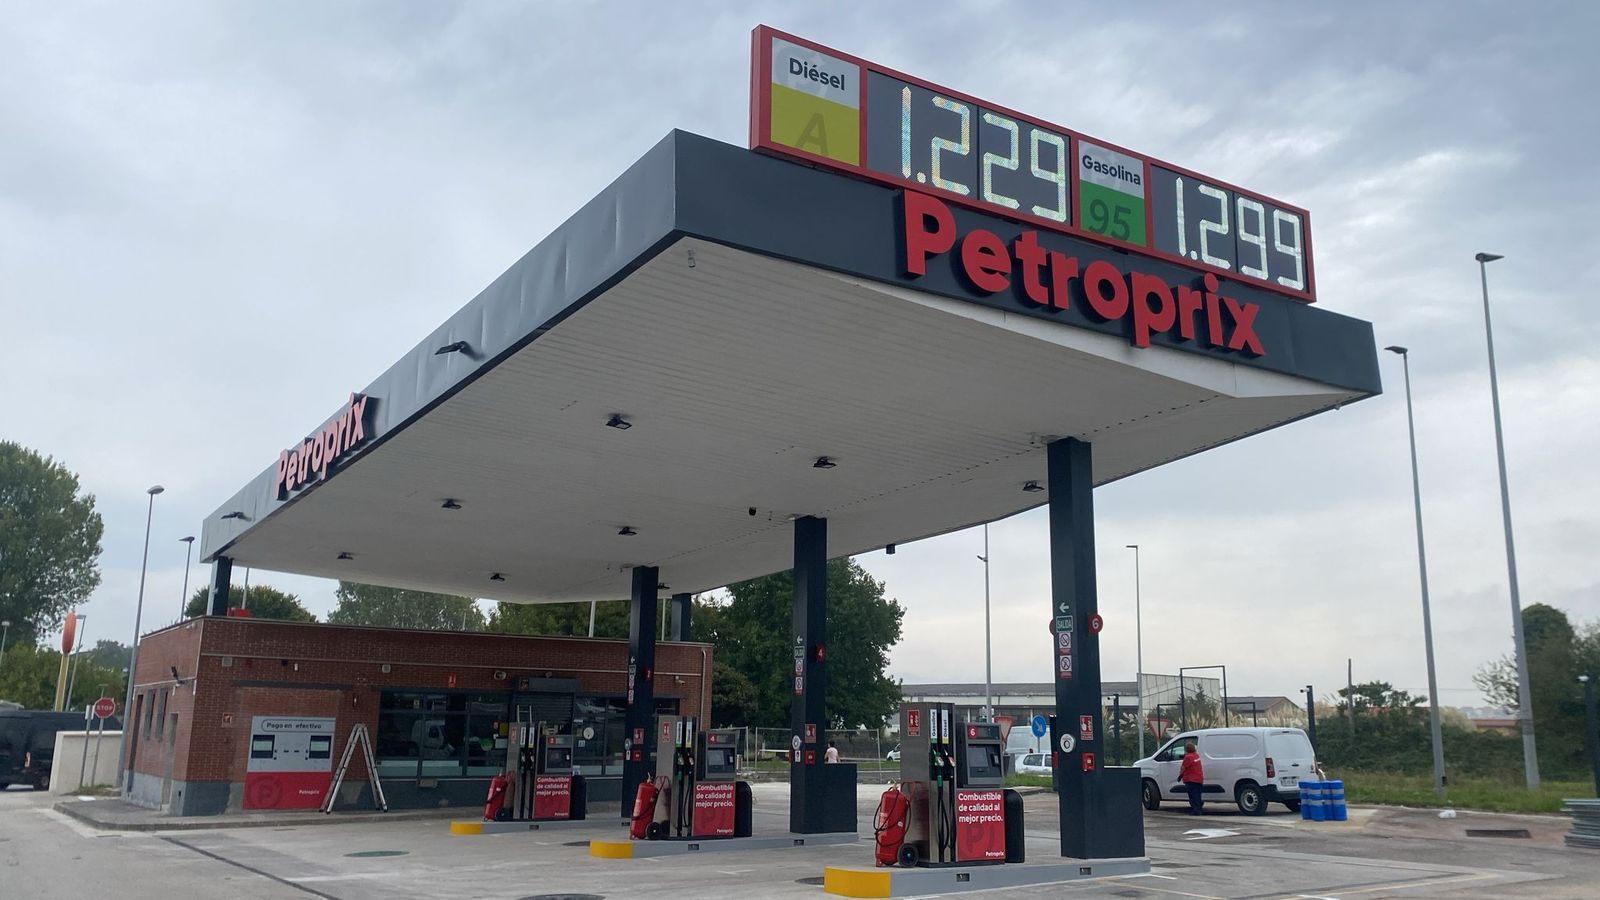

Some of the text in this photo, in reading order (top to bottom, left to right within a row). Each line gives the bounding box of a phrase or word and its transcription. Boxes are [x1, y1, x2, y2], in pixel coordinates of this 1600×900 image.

[789, 57, 845, 91] Diésel
[795, 112, 829, 156] A
[902, 86, 1067, 222] 1.229
[1082, 154, 1141, 186] Gasolina
[1088, 198, 1131, 241] 95
[1176, 177, 1304, 291] 1.299
[904, 189, 1266, 356] Petroprix
[273, 391, 368, 501] Petroprix
[1092, 618, 1099, 630] 6
[266, 722, 284, 730] Pago
[970, 728, 976, 736] 6
[695, 800, 734, 808] mejor precio.
[958, 792, 1002, 801] Combustible
[958, 803, 1000, 812] de calidad al
[958, 814, 1003, 824] mejor precio.
